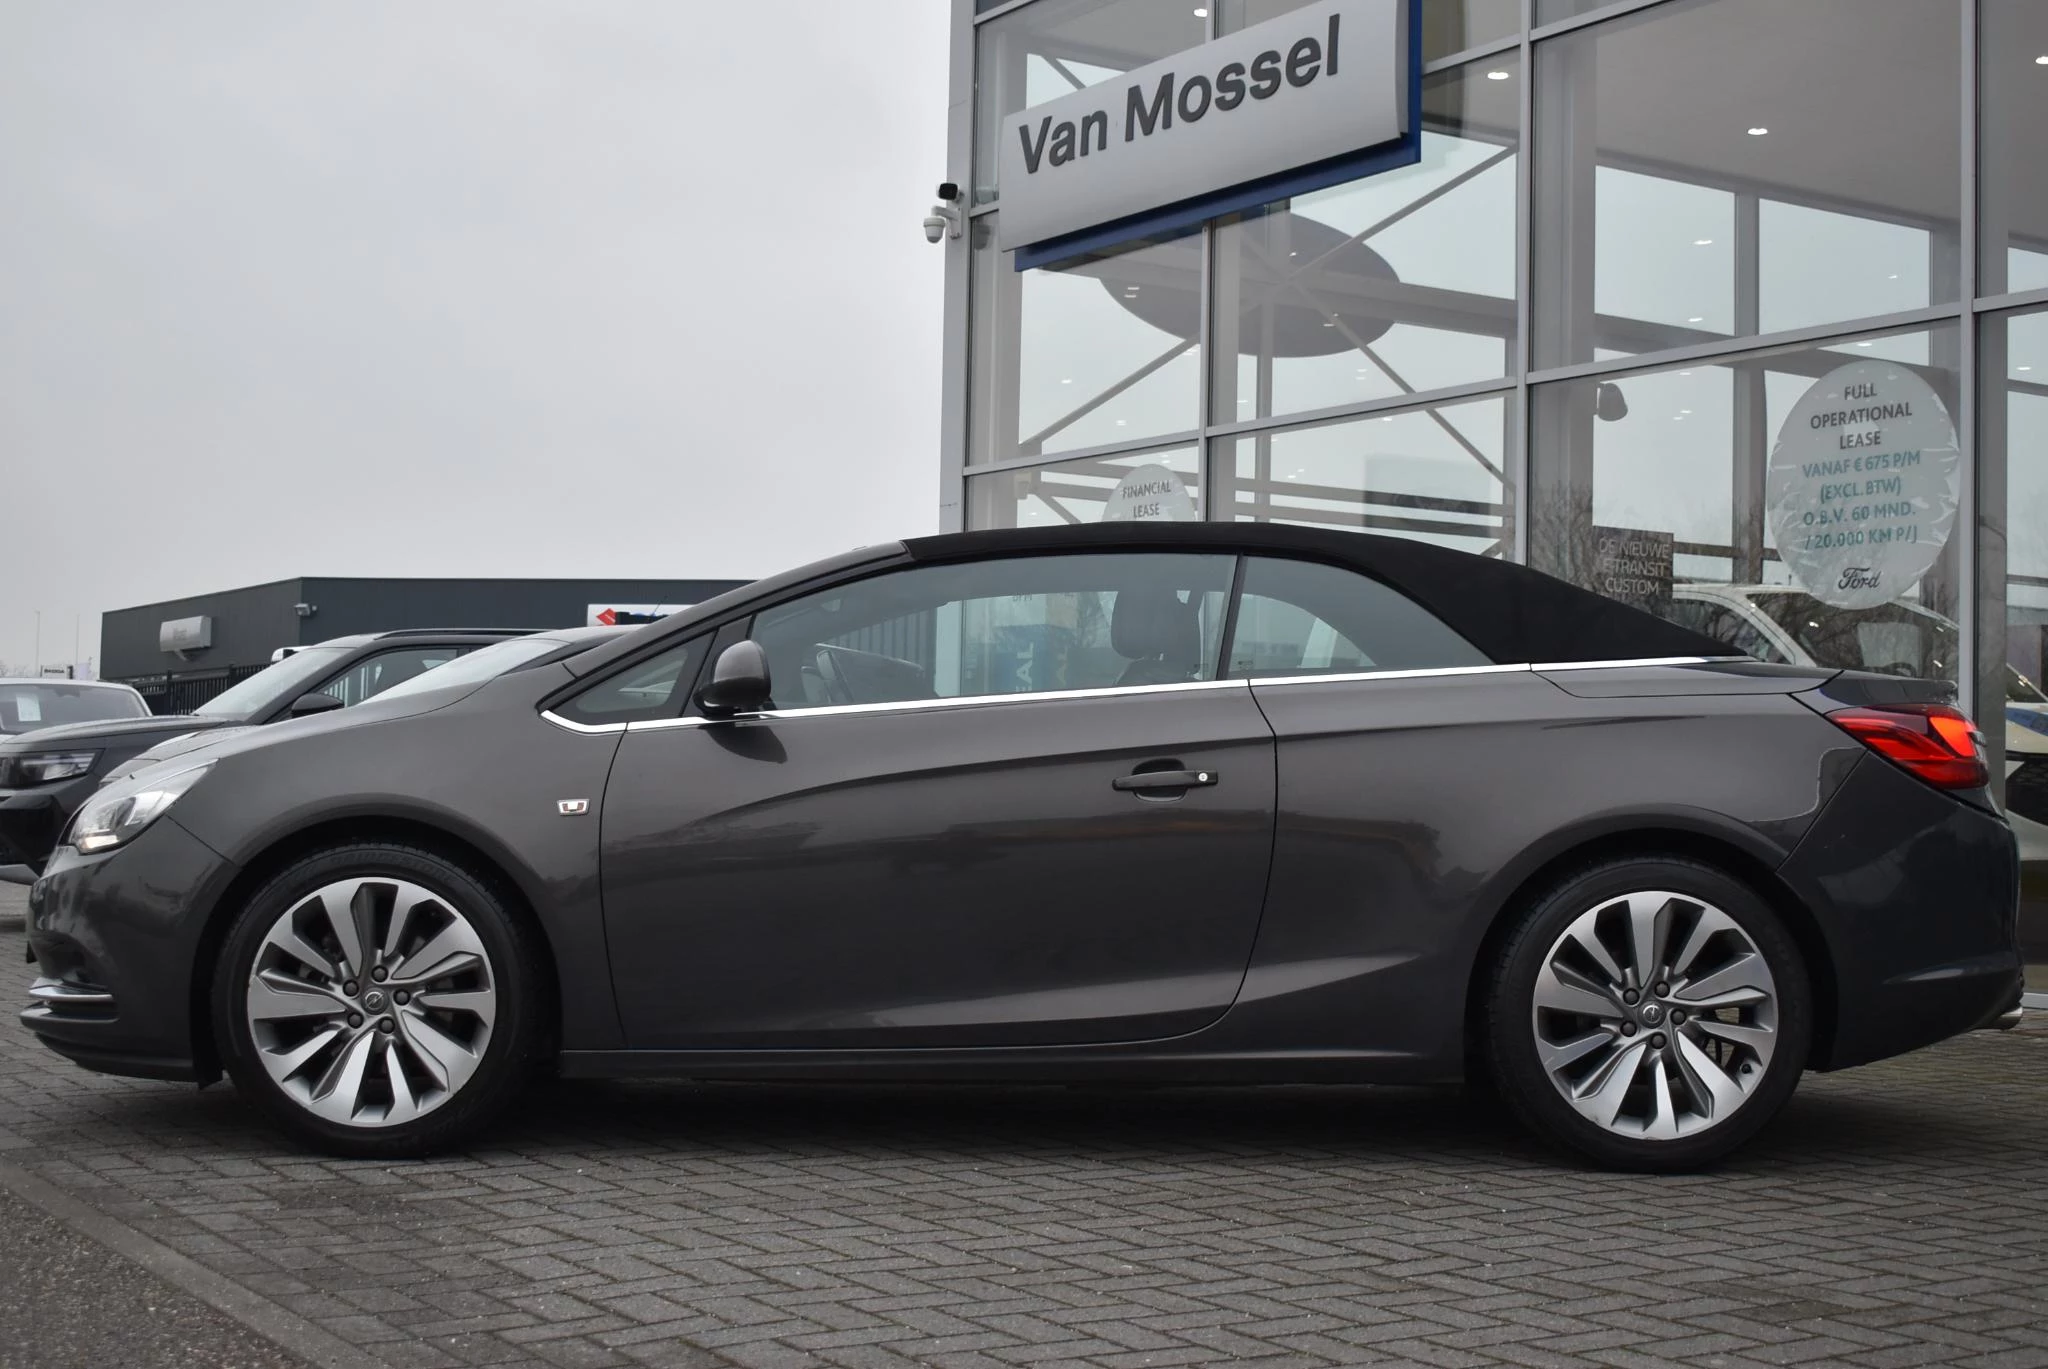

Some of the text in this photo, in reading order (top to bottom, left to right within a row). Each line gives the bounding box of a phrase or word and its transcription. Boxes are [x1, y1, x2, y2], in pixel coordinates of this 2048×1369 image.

[1018, 13, 1341, 175] Van Mossel
[1844, 382, 1877, 400] FULL
[1810, 402, 1912, 429] OPERATIONAL
[1839, 431, 1881, 449] LEASE
[1802, 459, 1850, 478] VANAF
[1865, 454, 1889, 470] 675
[1893, 450, 1921, 468] P/M
[1122, 480, 1171, 498] FINANCIAL
[1133, 503, 1160, 518] LEASE
[1803, 501, 1916, 526] O.B.V. 60 MND.
[1814, 530, 1864, 549] 20.000
[1868, 528, 1892, 544] KM
[1896, 525, 1917, 544] P/J
[1600, 538, 1669, 559] DE NIEUWE
[1605, 577, 1659, 595] CUSTOM
[1838, 567, 1881, 590] Ford
